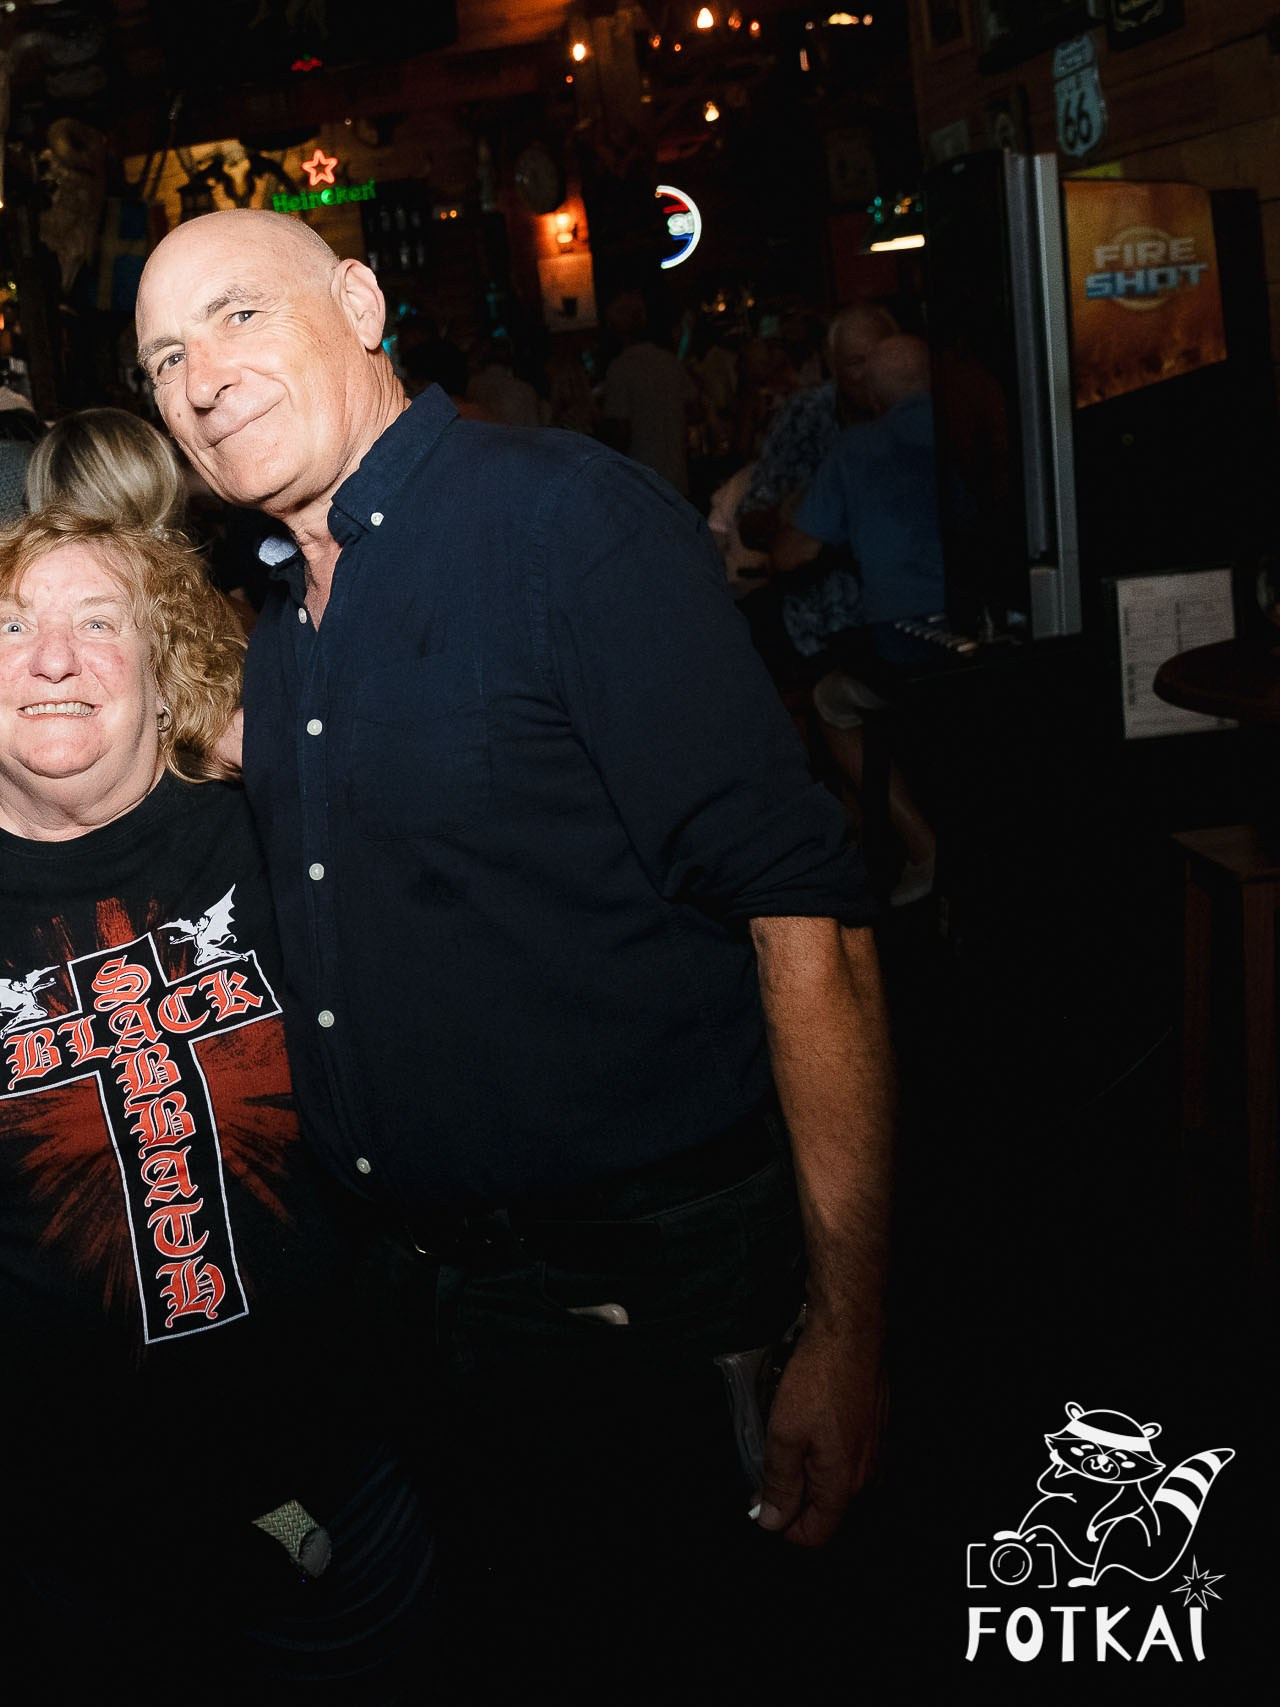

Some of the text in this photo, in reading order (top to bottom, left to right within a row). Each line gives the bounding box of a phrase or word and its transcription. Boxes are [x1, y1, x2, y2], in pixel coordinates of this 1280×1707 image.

[1063, 91, 1092, 149] 66
[1086, 263, 1209, 299] SHOT
[1094, 238, 1197, 269] FIRE
[2, 967, 264, 1091] BLACK
[91, 954, 227, 1329] SABBATH
